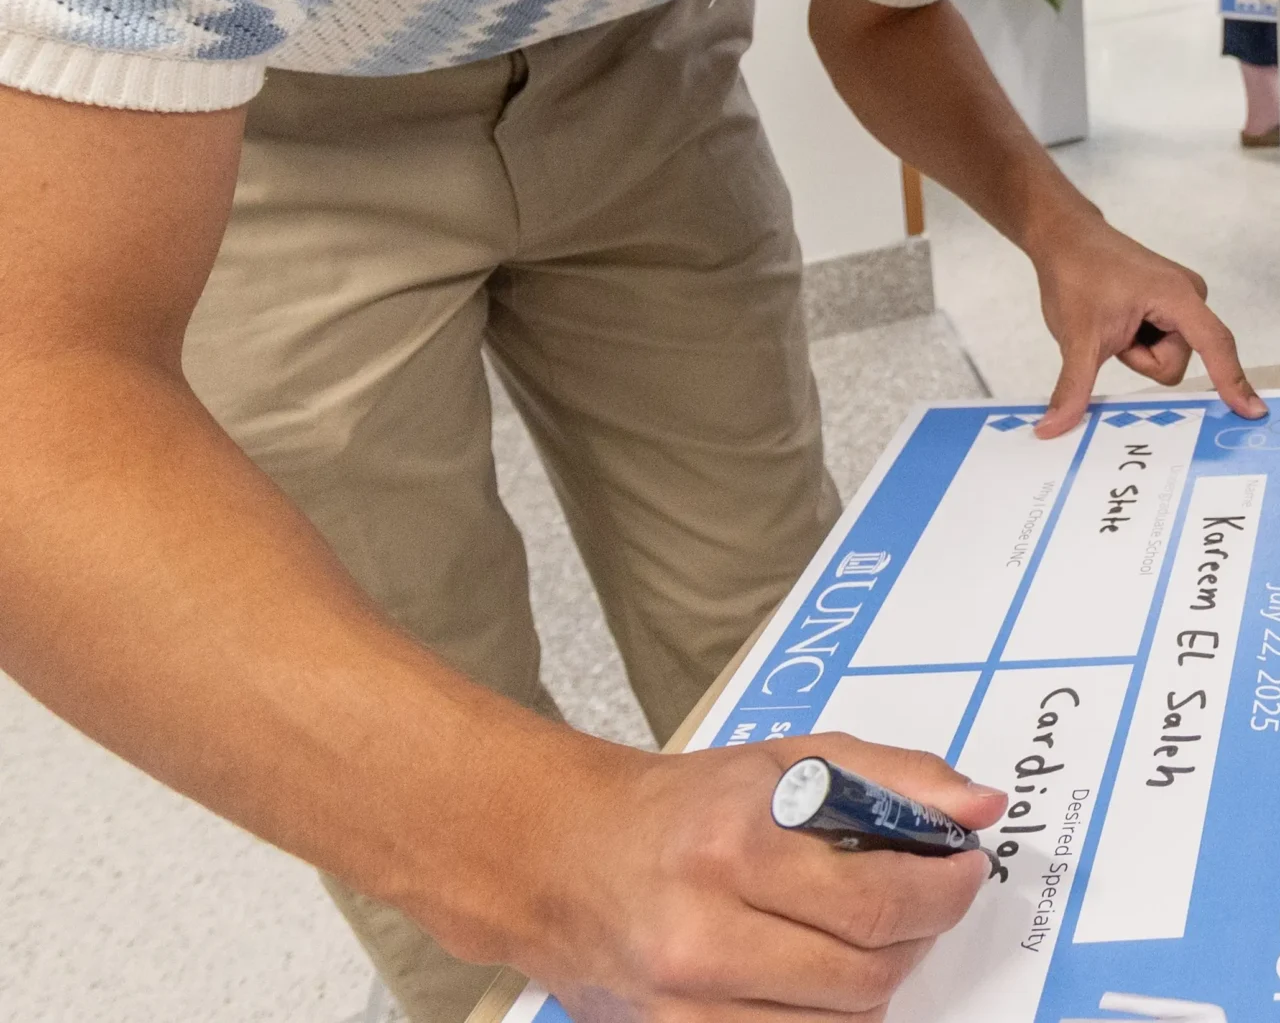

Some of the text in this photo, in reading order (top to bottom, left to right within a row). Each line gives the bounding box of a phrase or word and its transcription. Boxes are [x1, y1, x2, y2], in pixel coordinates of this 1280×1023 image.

[1033, 480, 1056, 503] Why
[1099, 444, 1153, 533] NC State
[1241, 479, 1259, 508] Name
[1006, 542, 1029, 568] UNC
[1018, 509, 1043, 541] Chose
[1139, 538, 1162, 576] School
[1189, 516, 1246, 610] Kareem
[761, 577, 878, 695] UNC
[1146, 689, 1206, 787] Saleh
[1021, 789, 1090, 953] Desired Specialty
